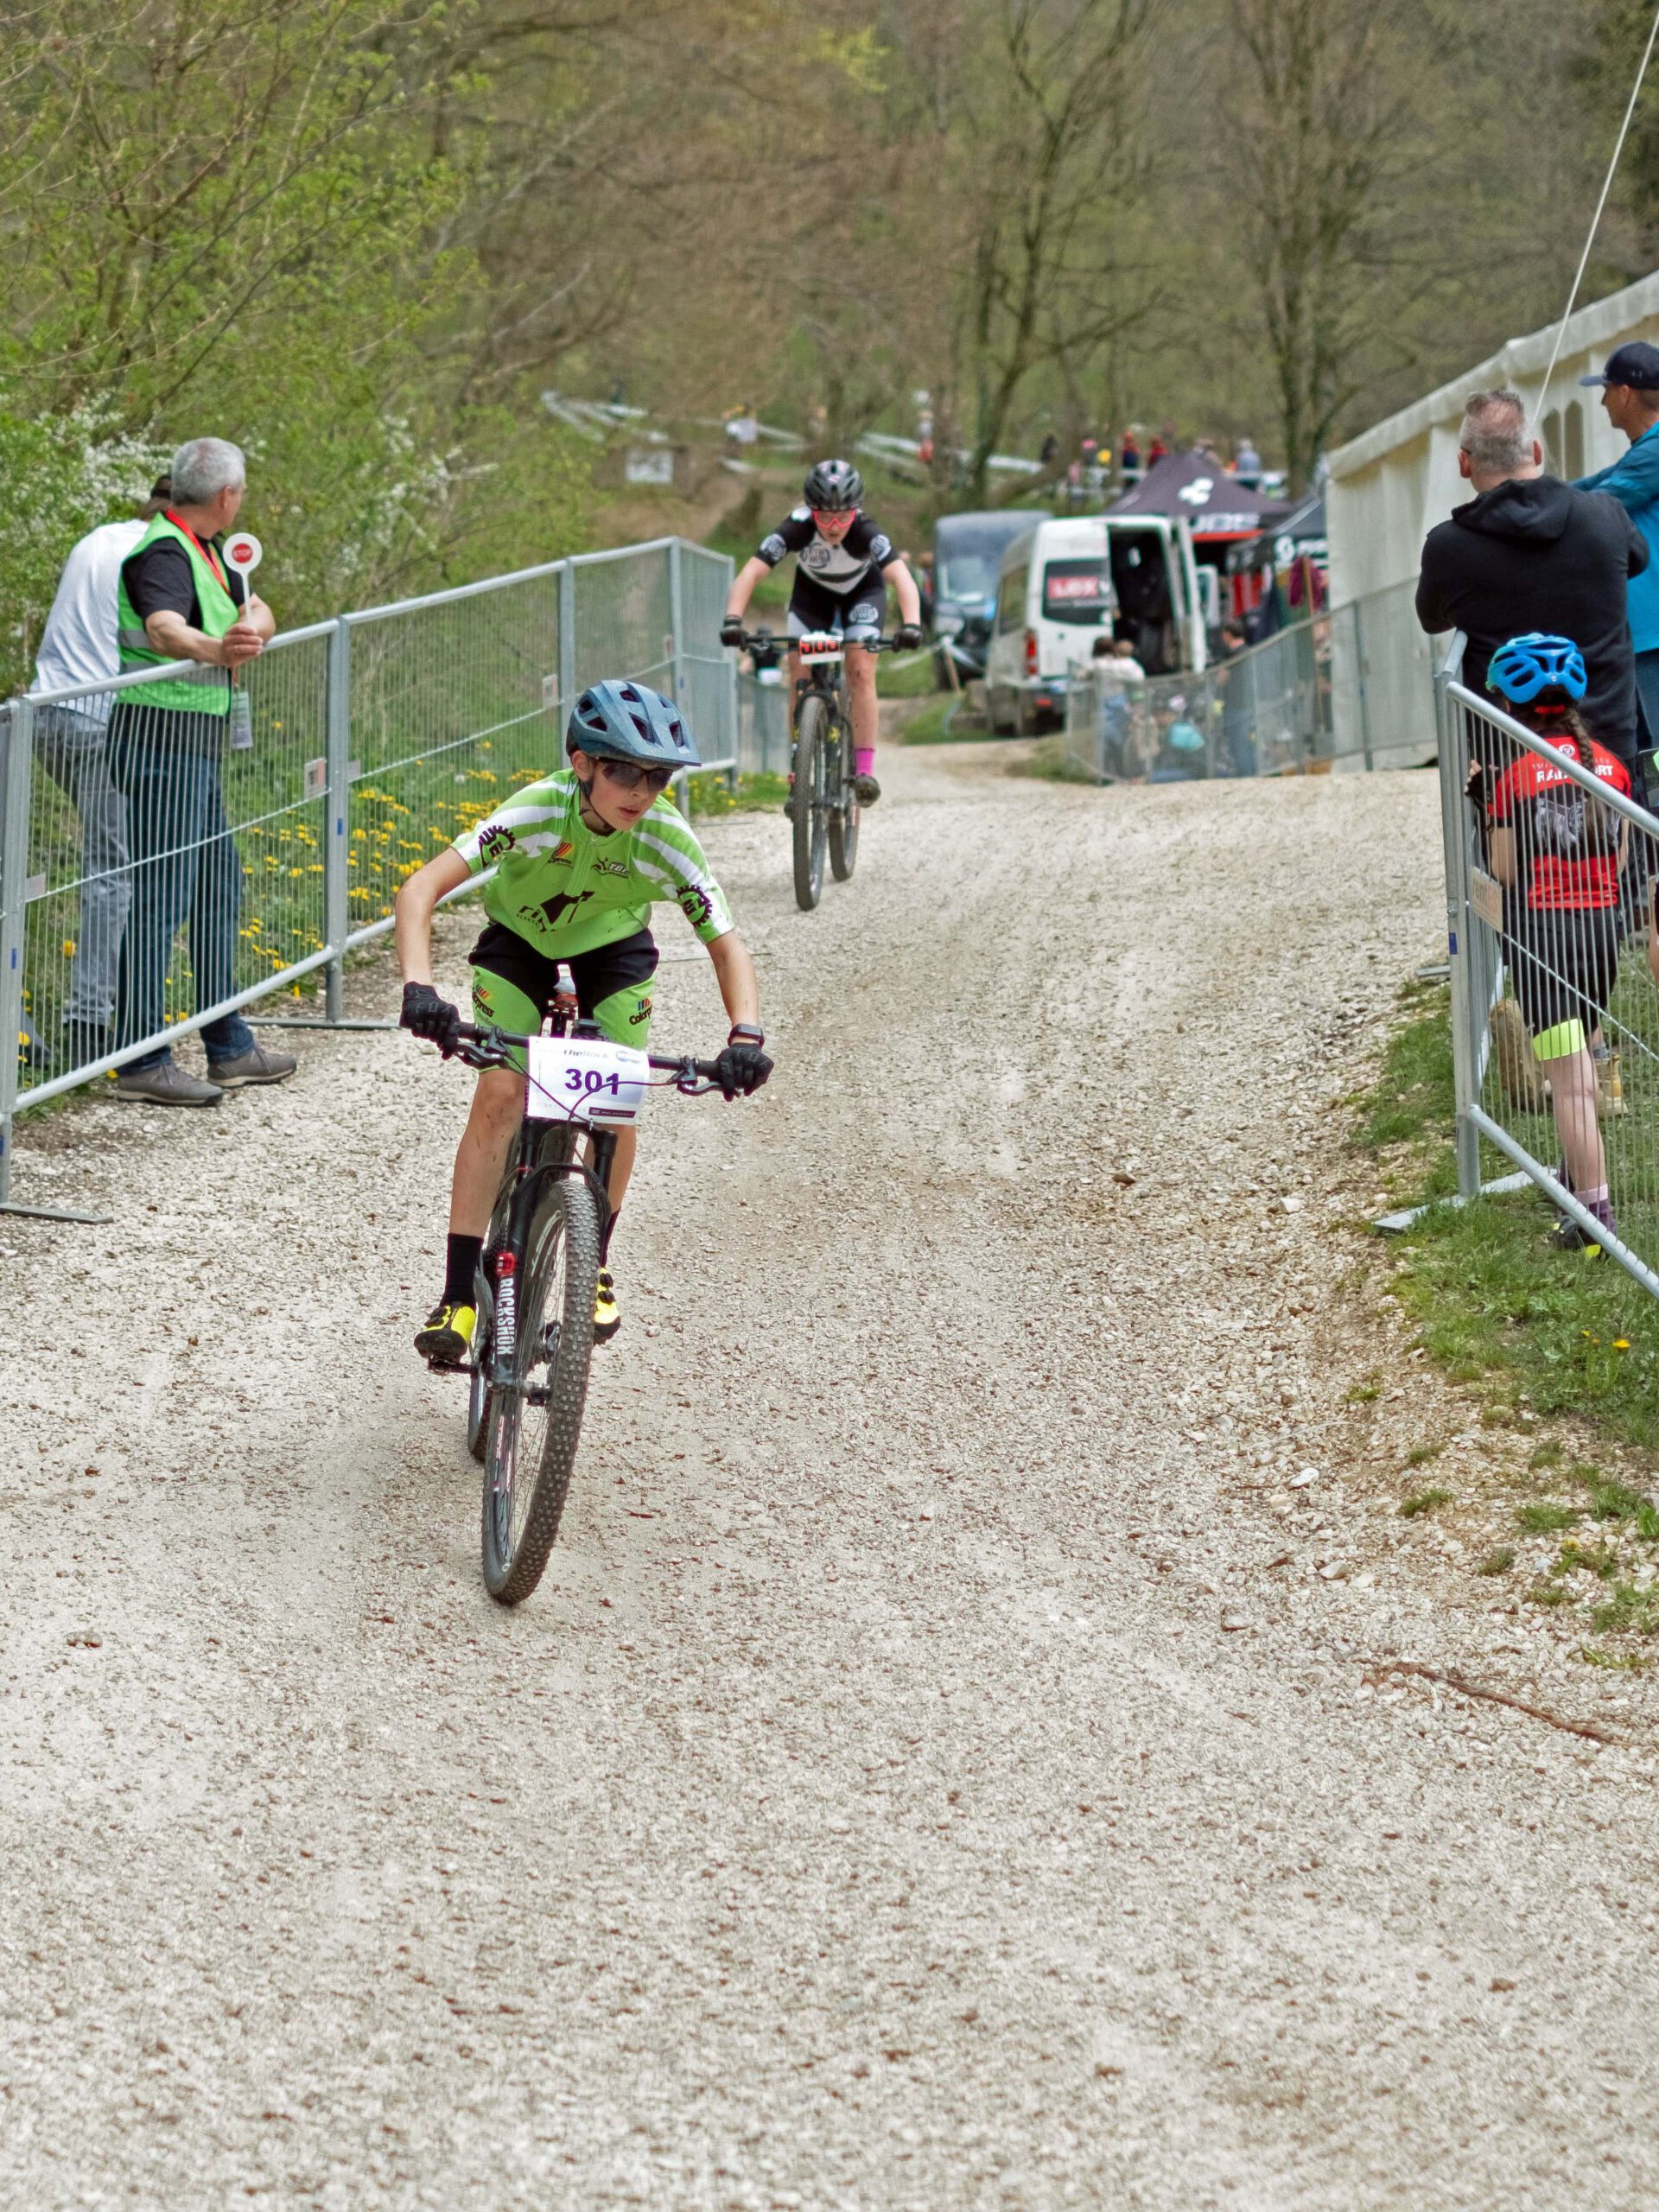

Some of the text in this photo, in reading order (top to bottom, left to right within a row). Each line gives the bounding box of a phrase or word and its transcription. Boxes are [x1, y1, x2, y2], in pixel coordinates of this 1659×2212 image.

[232, 548, 252, 558] STOP
[564, 1068, 620, 1096] 301
[496, 1277, 516, 1355] ROCKSHOX
